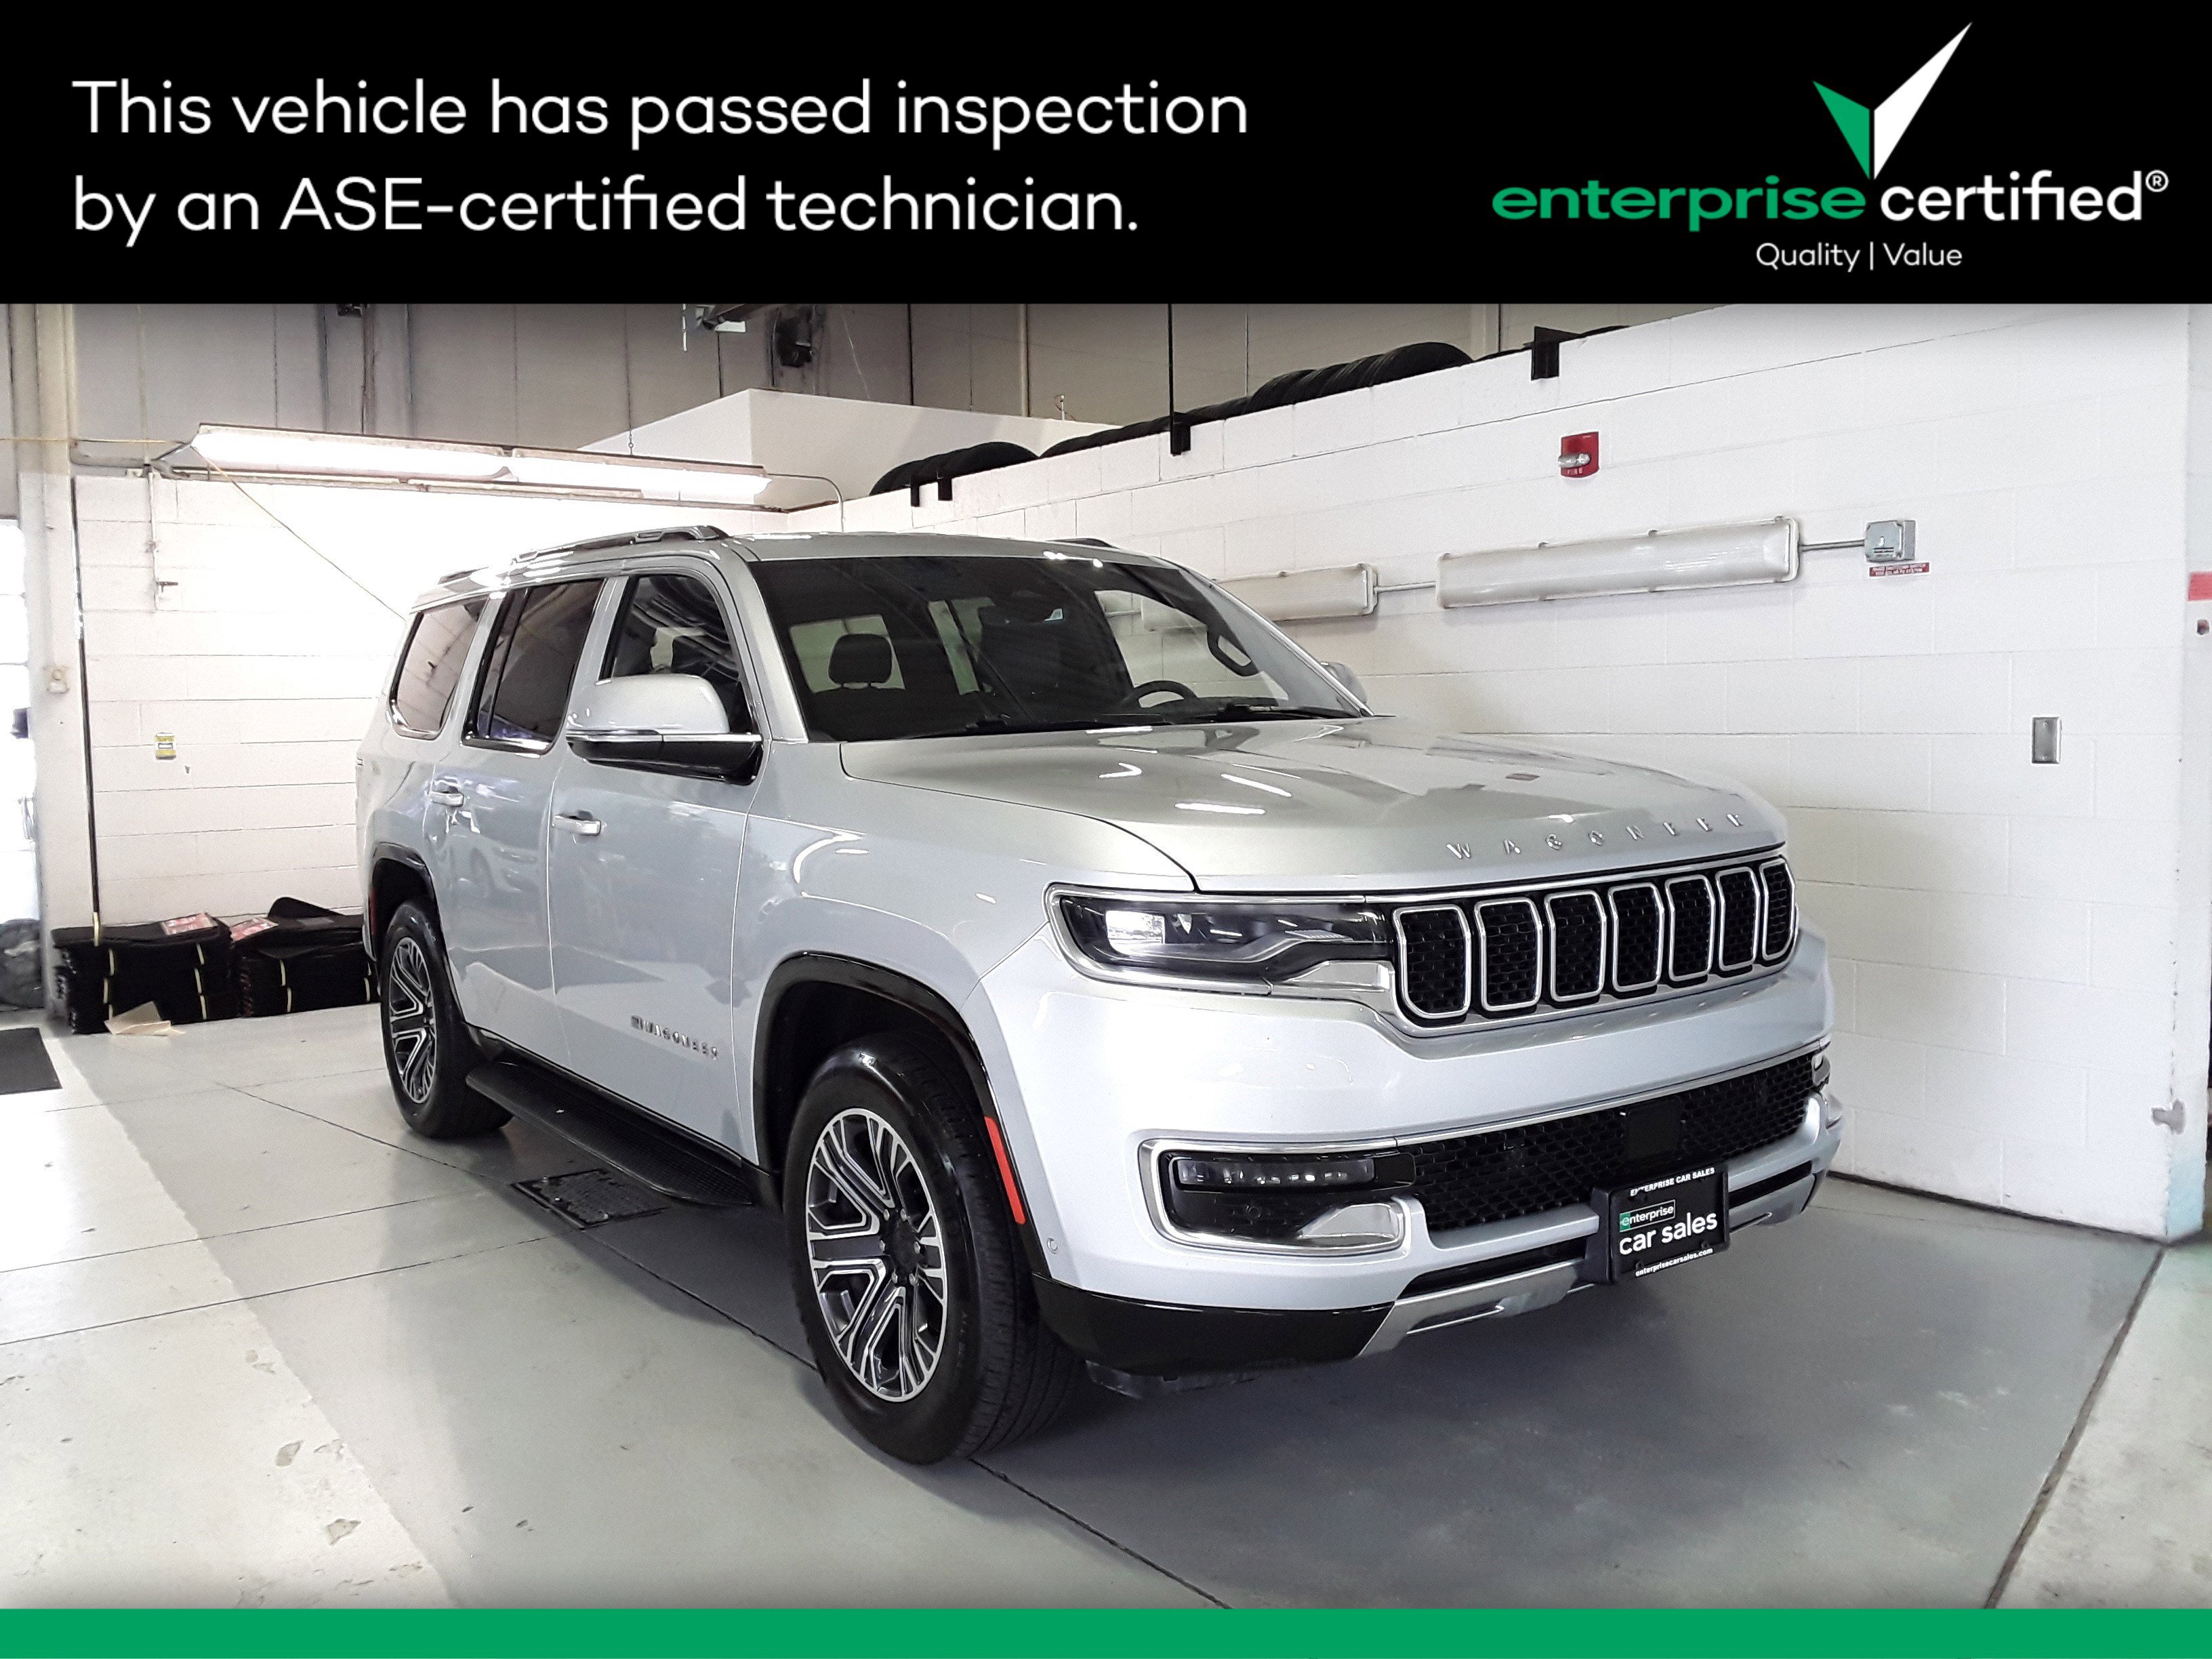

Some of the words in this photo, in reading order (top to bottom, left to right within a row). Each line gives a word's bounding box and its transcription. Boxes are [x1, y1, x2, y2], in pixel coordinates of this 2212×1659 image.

[1446, 813, 1744, 859] WAGONEER
[1676, 1173, 1691, 1184] CAR
[1692, 1167, 1715, 1179] SALES
[1621, 1206, 1674, 1226] enterprise
[1620, 1229, 1656, 1254] car
[1661, 1212, 1717, 1243] sales
[1635, 1248, 1713, 1276] enterprisecarsales.com
